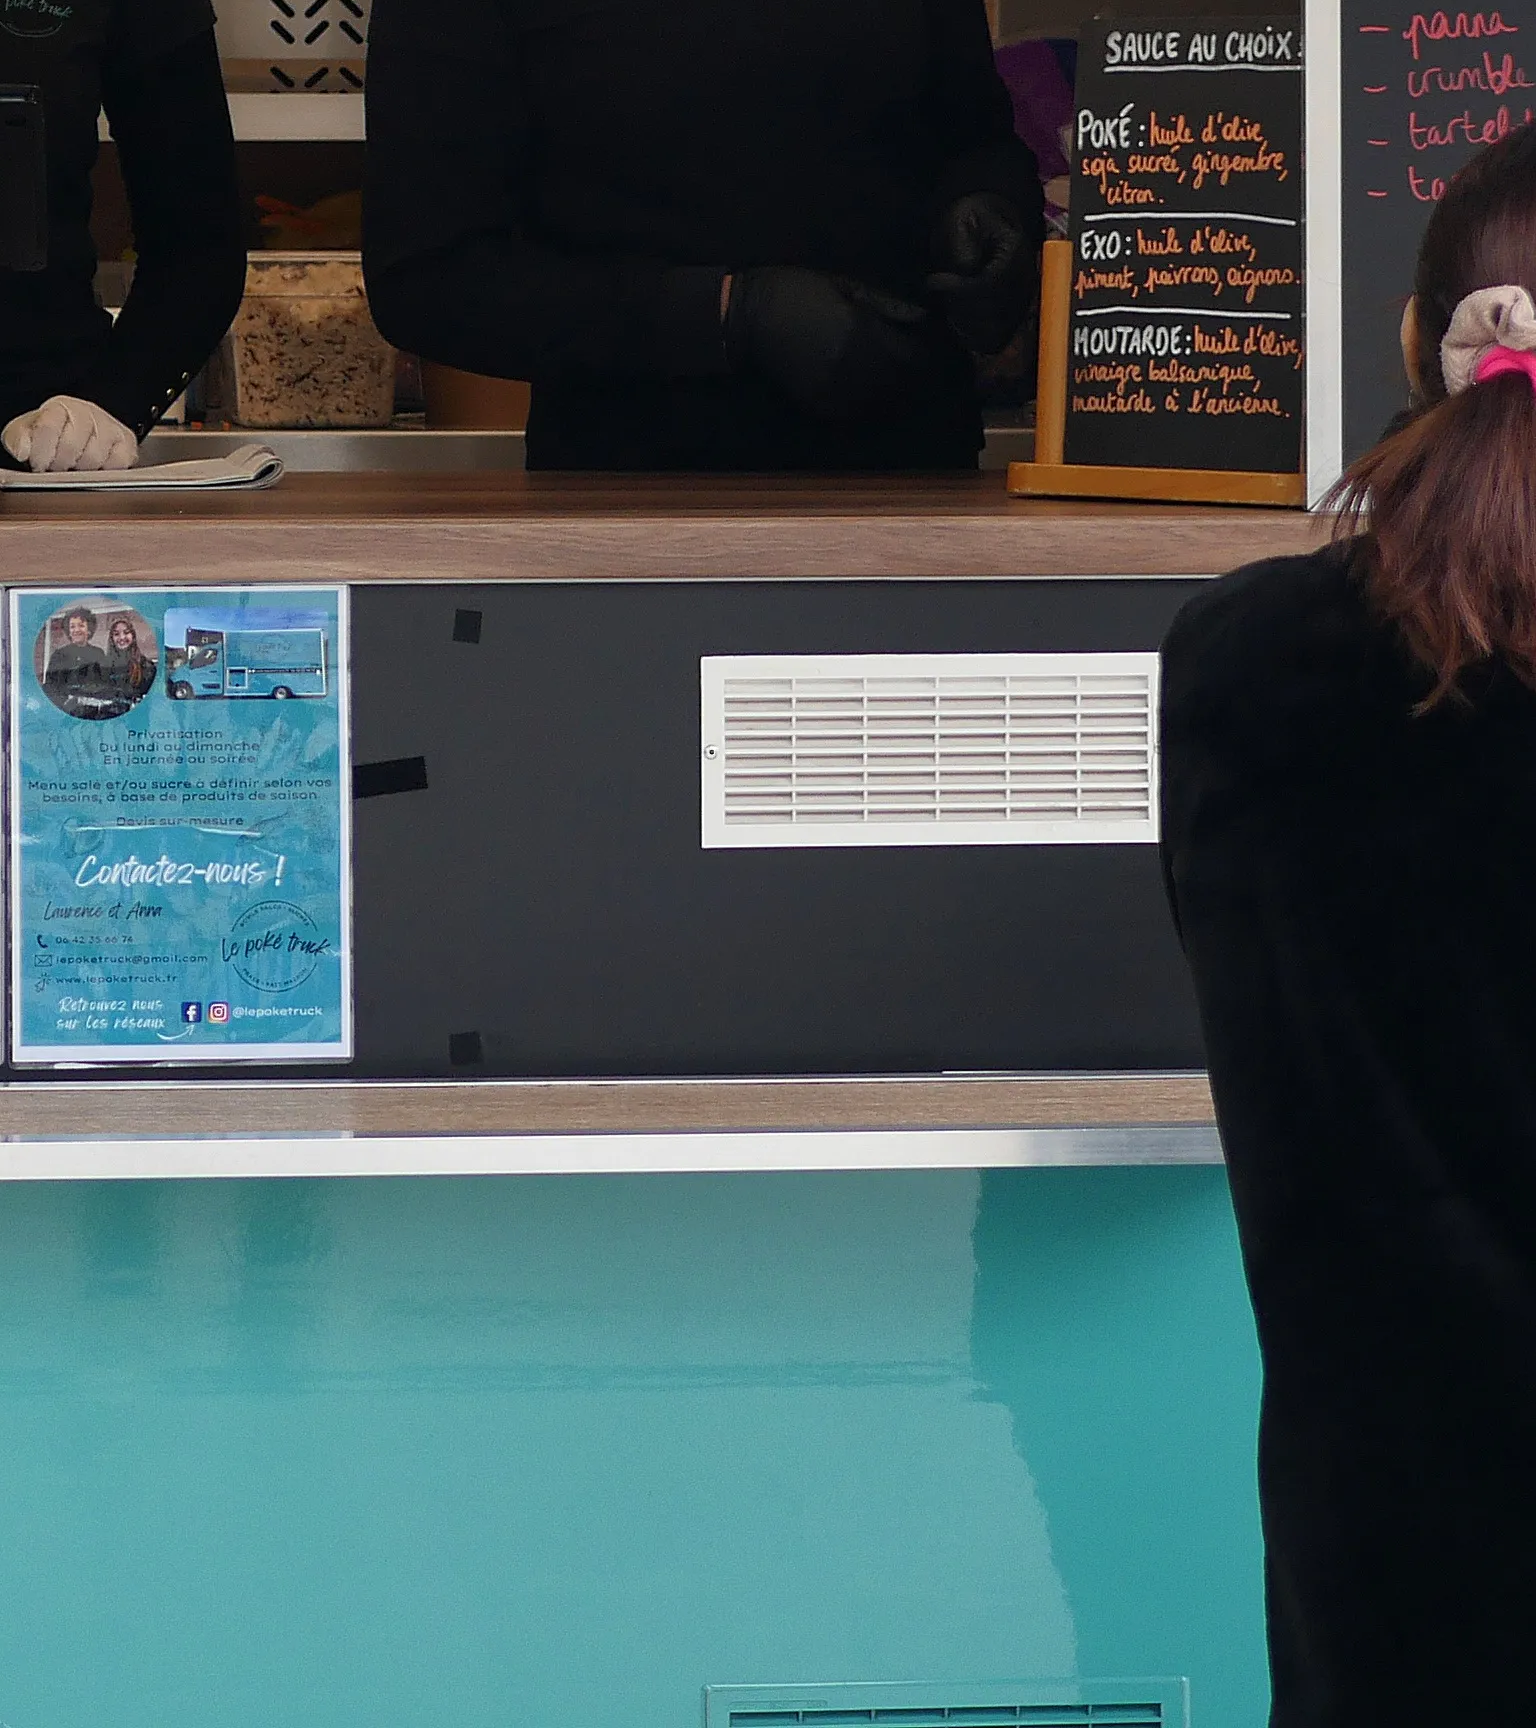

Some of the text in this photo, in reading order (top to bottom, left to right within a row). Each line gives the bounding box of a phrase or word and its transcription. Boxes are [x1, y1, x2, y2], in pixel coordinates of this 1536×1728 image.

[1105, 31, 1180, 64] SAUCE
[1187, 33, 1216, 62] AU
[1402, 11, 1518, 60] panna
[1407, 51, 1535, 96] crumble
[1149, 111, 1194, 147] huile
[1081, 151, 1119, 194] soja
[1137, 226, 1183, 255] huile
[1194, 324, 1240, 354] huile
[1074, 361, 1142, 393] vinaigre
[1073, 388, 1155, 414] moutarde
[1164, 389, 1179, 411] à
[127, 729, 223, 739] Privatisation
[221, 930, 331, 963] Le poké truck
